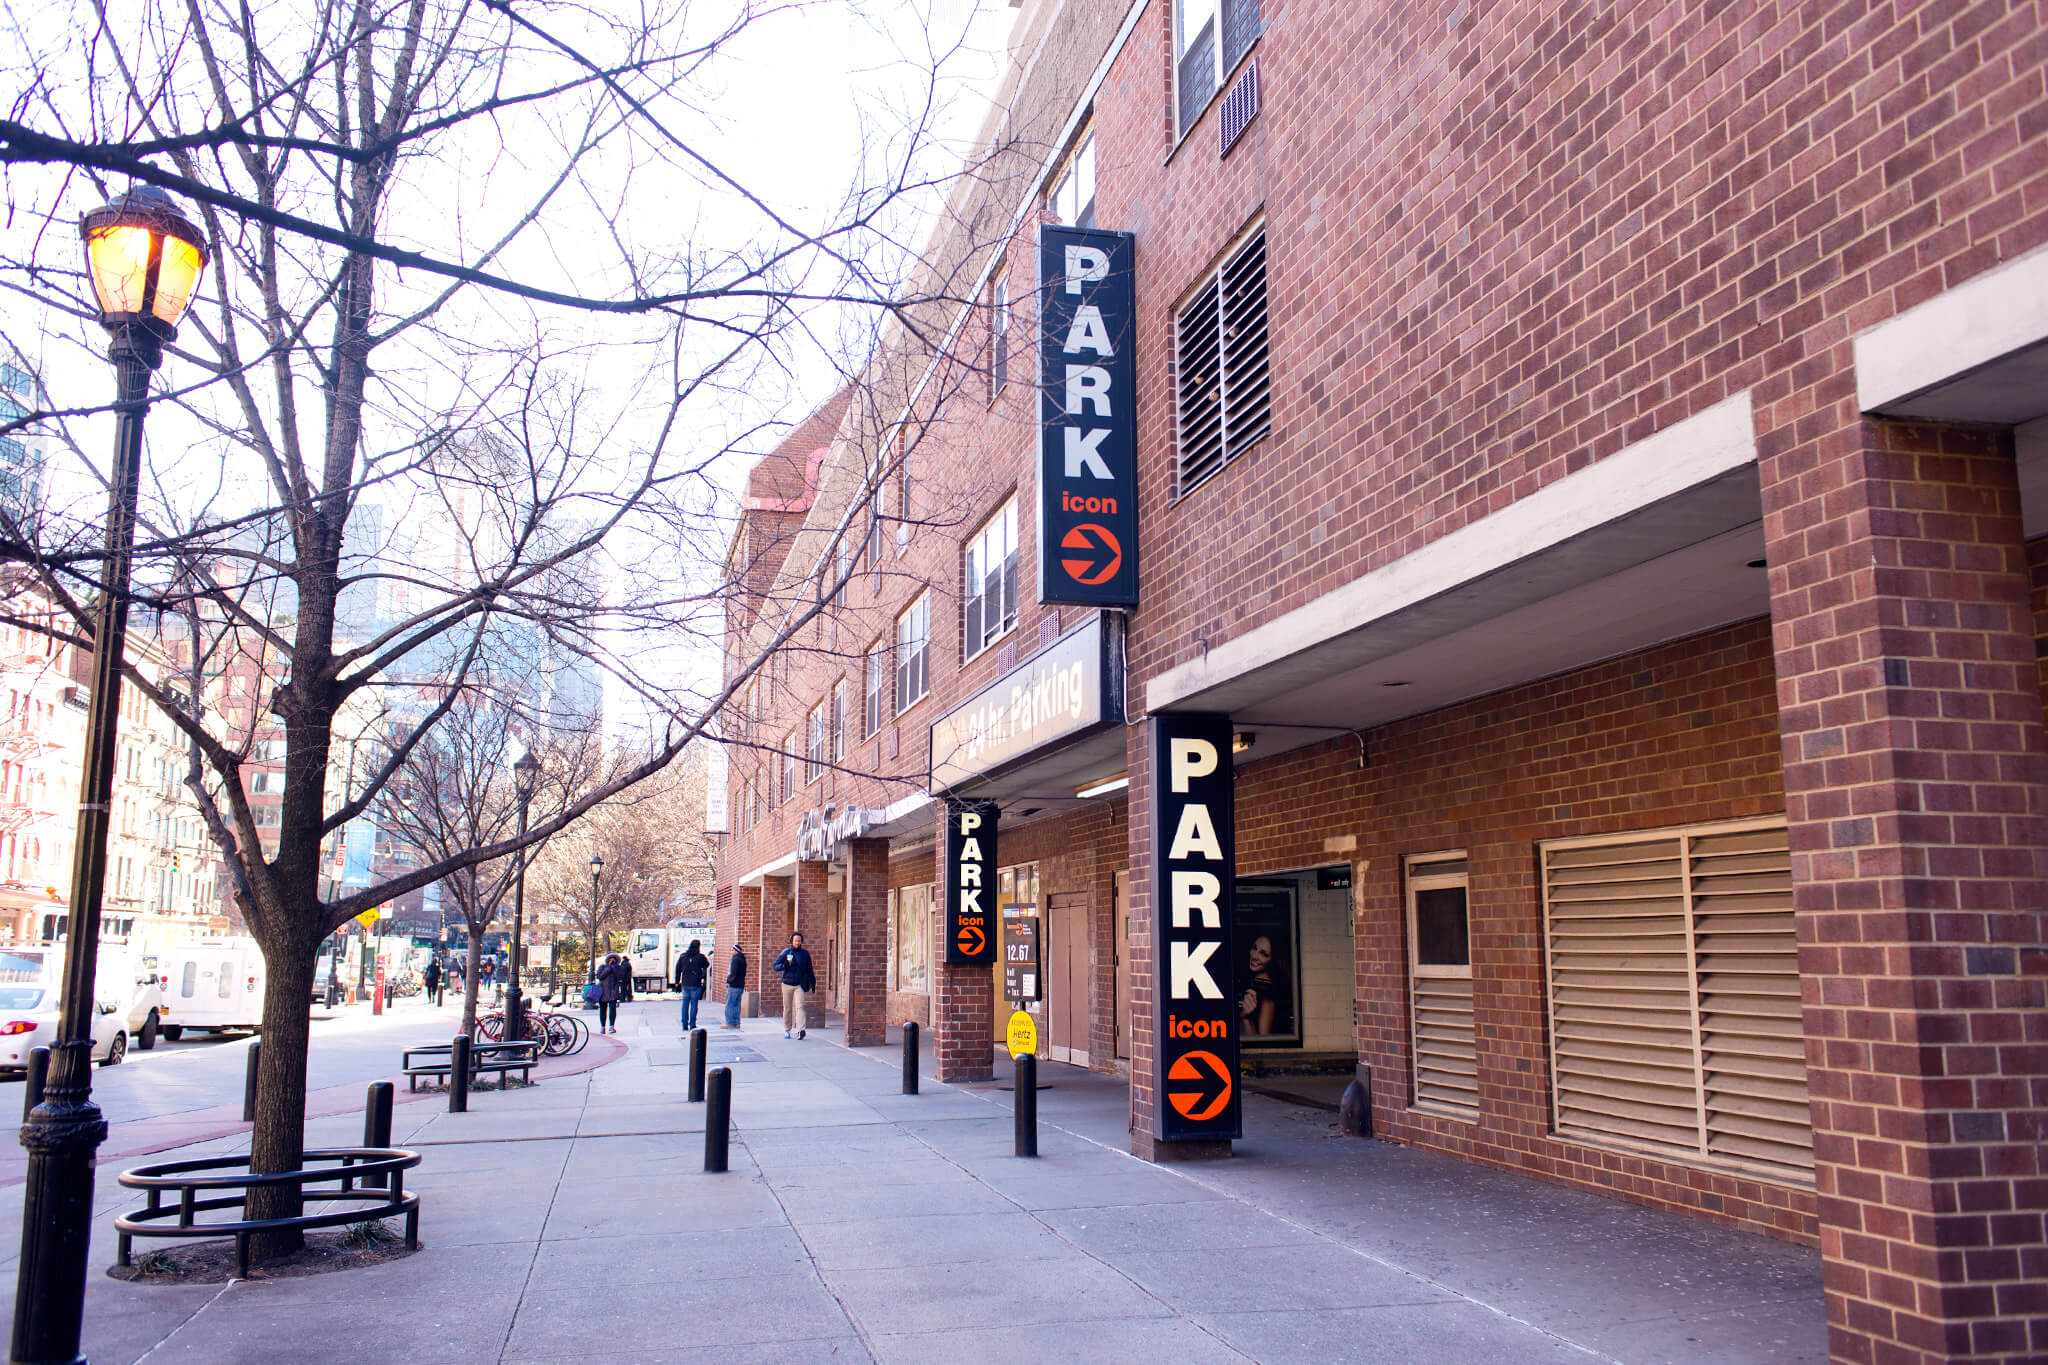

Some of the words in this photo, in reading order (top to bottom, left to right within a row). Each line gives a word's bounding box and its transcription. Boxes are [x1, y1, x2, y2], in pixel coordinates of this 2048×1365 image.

[1063, 244, 1115, 480] PARK
[1062, 491, 1117, 514] icon
[967, 706, 985, 760] 24
[988, 701, 1007, 748] hr.
[1011, 660, 1083, 737] Parking
[960, 812, 983, 913] PARK
[1168, 737, 1225, 999] PARK
[958, 915, 984, 926] icon
[1007, 944, 1029, 961] 12.67
[1169, 1014, 1227, 1038] icon
